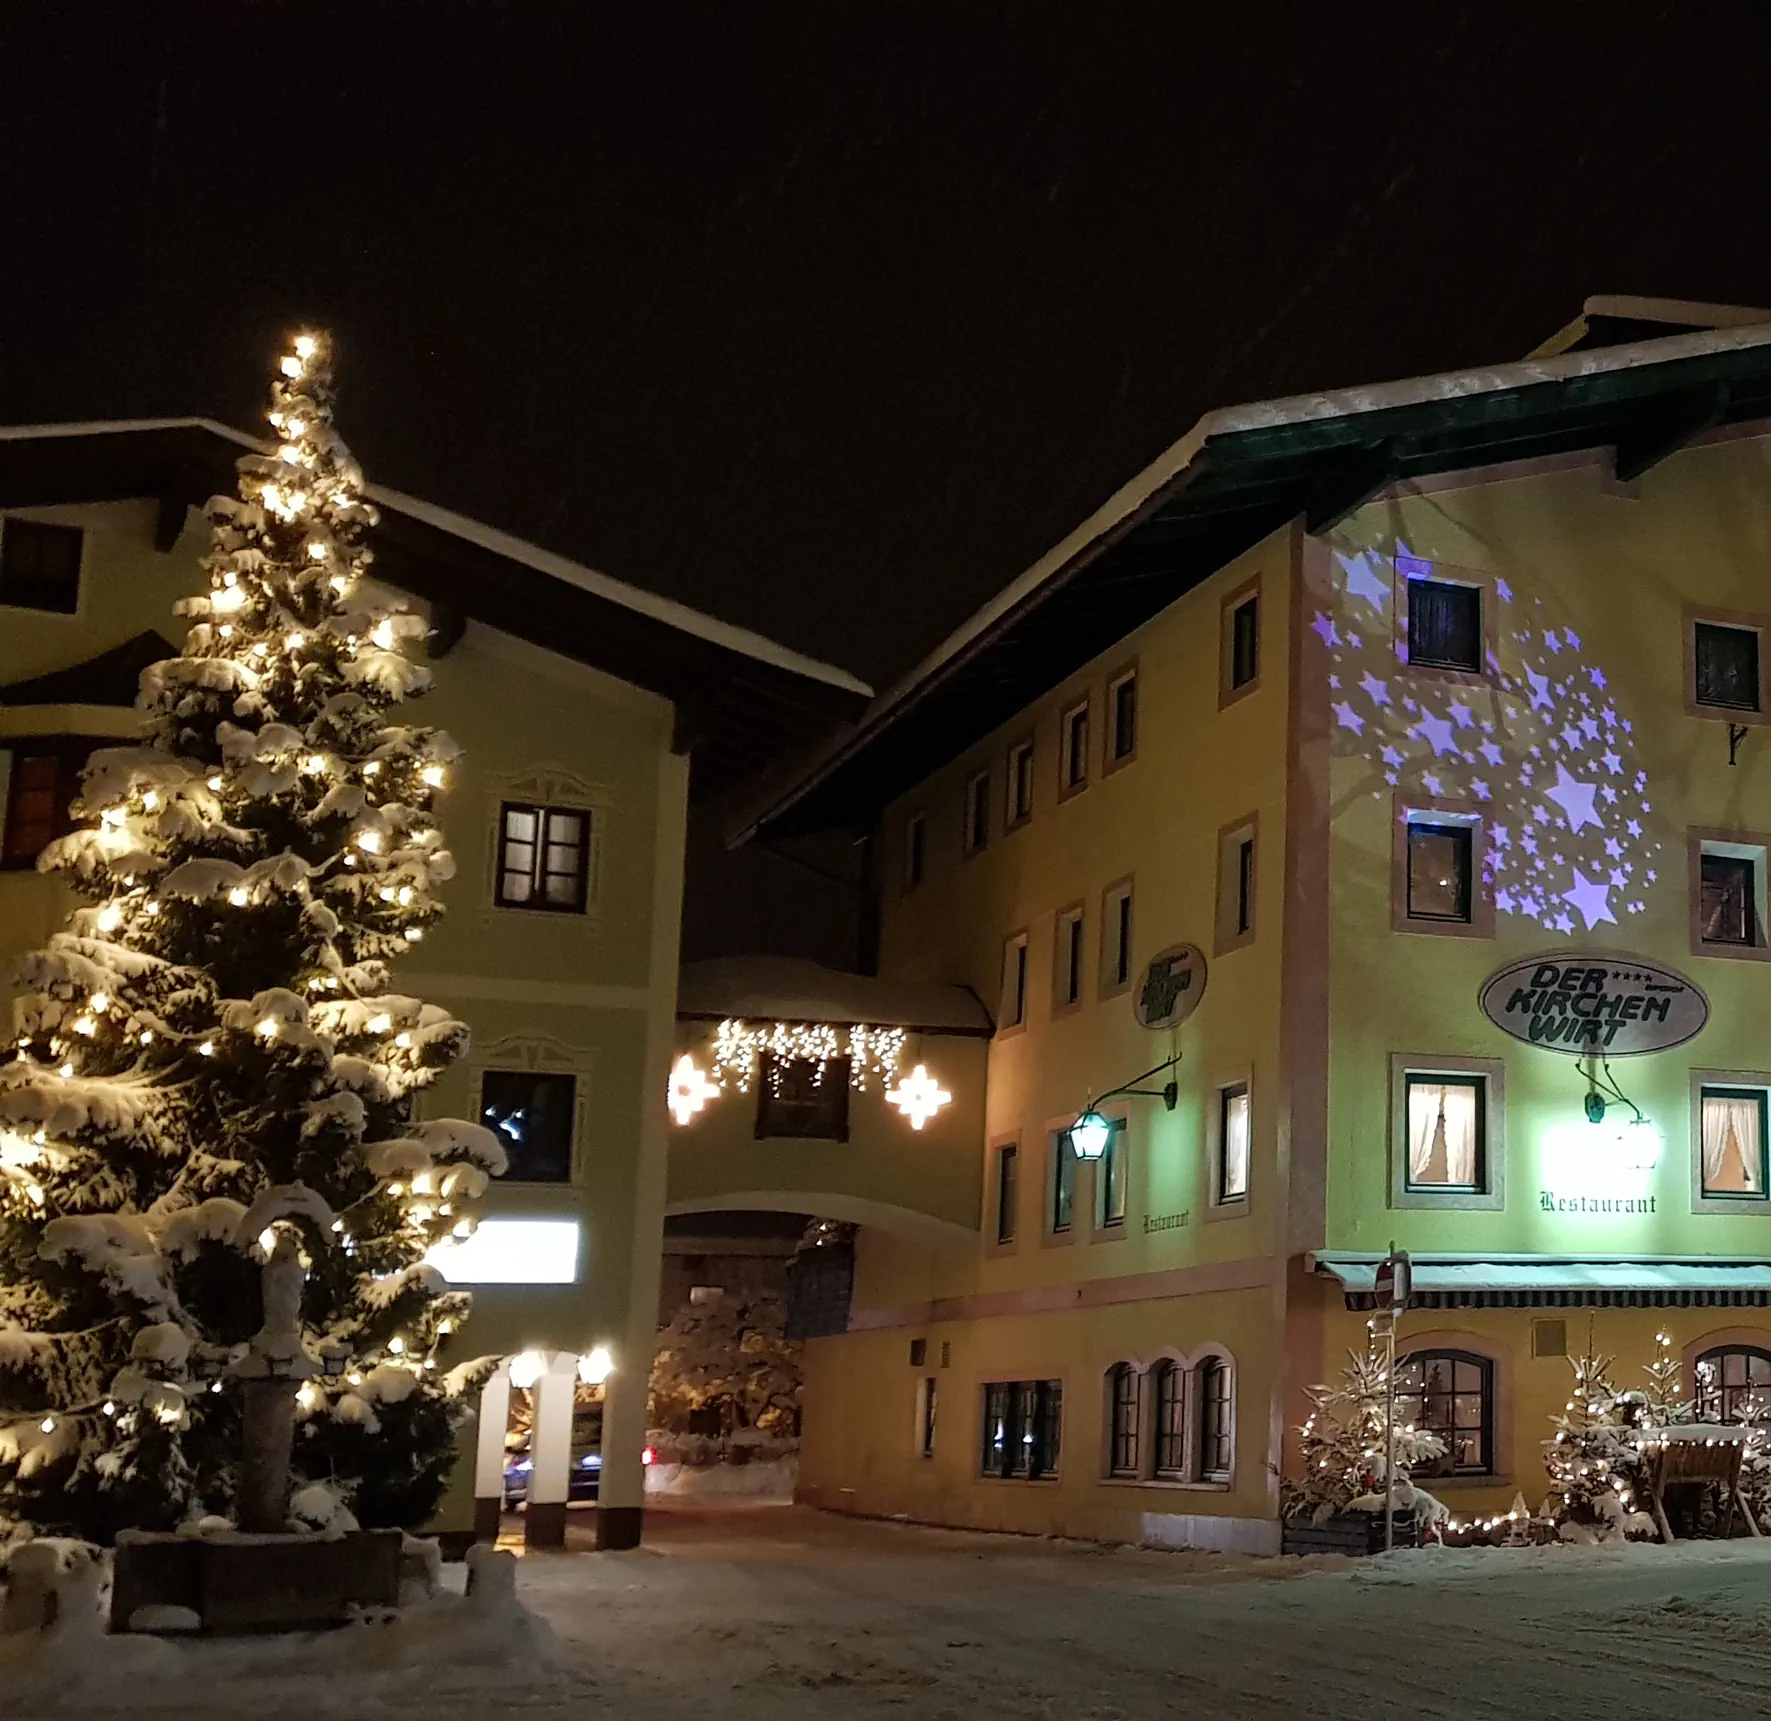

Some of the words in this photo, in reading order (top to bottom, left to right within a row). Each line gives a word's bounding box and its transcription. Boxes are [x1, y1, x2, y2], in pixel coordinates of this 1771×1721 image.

[1531, 965, 1607, 992] DER
[1505, 988, 1671, 1023] KIRCHEN
[1528, 1015, 1626, 1046] WIRT
[1540, 1191, 1656, 1213] Restaurant
